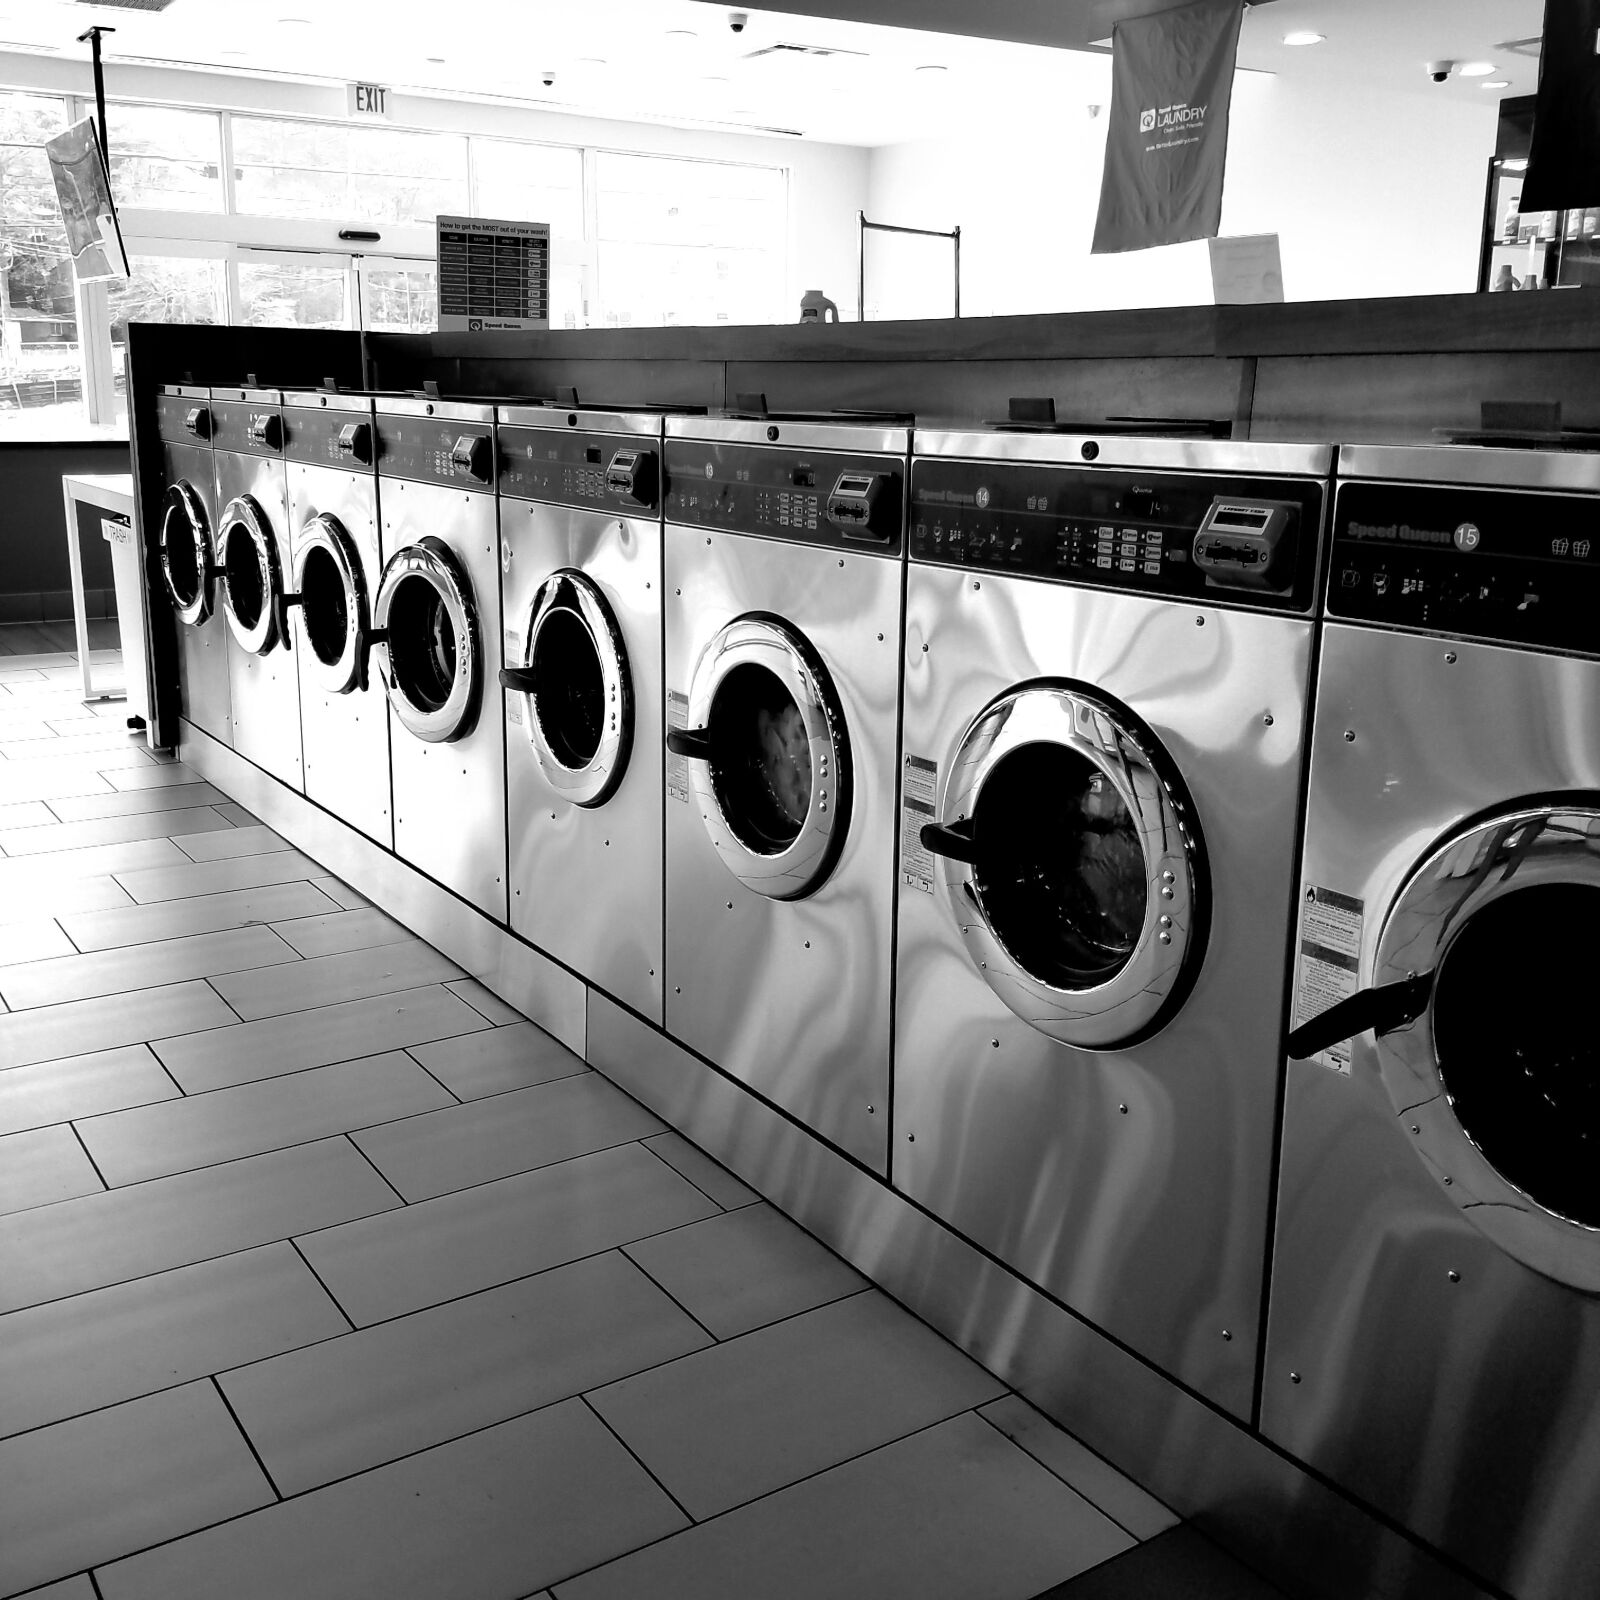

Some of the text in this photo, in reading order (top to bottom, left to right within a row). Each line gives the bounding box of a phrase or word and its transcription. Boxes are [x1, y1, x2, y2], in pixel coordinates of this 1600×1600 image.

[356, 86, 386, 114] EXIT
[1157, 105, 1208, 128] LAUNDRY
[461, 223, 471, 231] get
[517, 228, 529, 236] your
[977, 491, 988, 504] 14
[108, 525, 128, 544] TRASH
[1347, 521, 1452, 544] Speed Queen
[1456, 528, 1478, 545] 15
